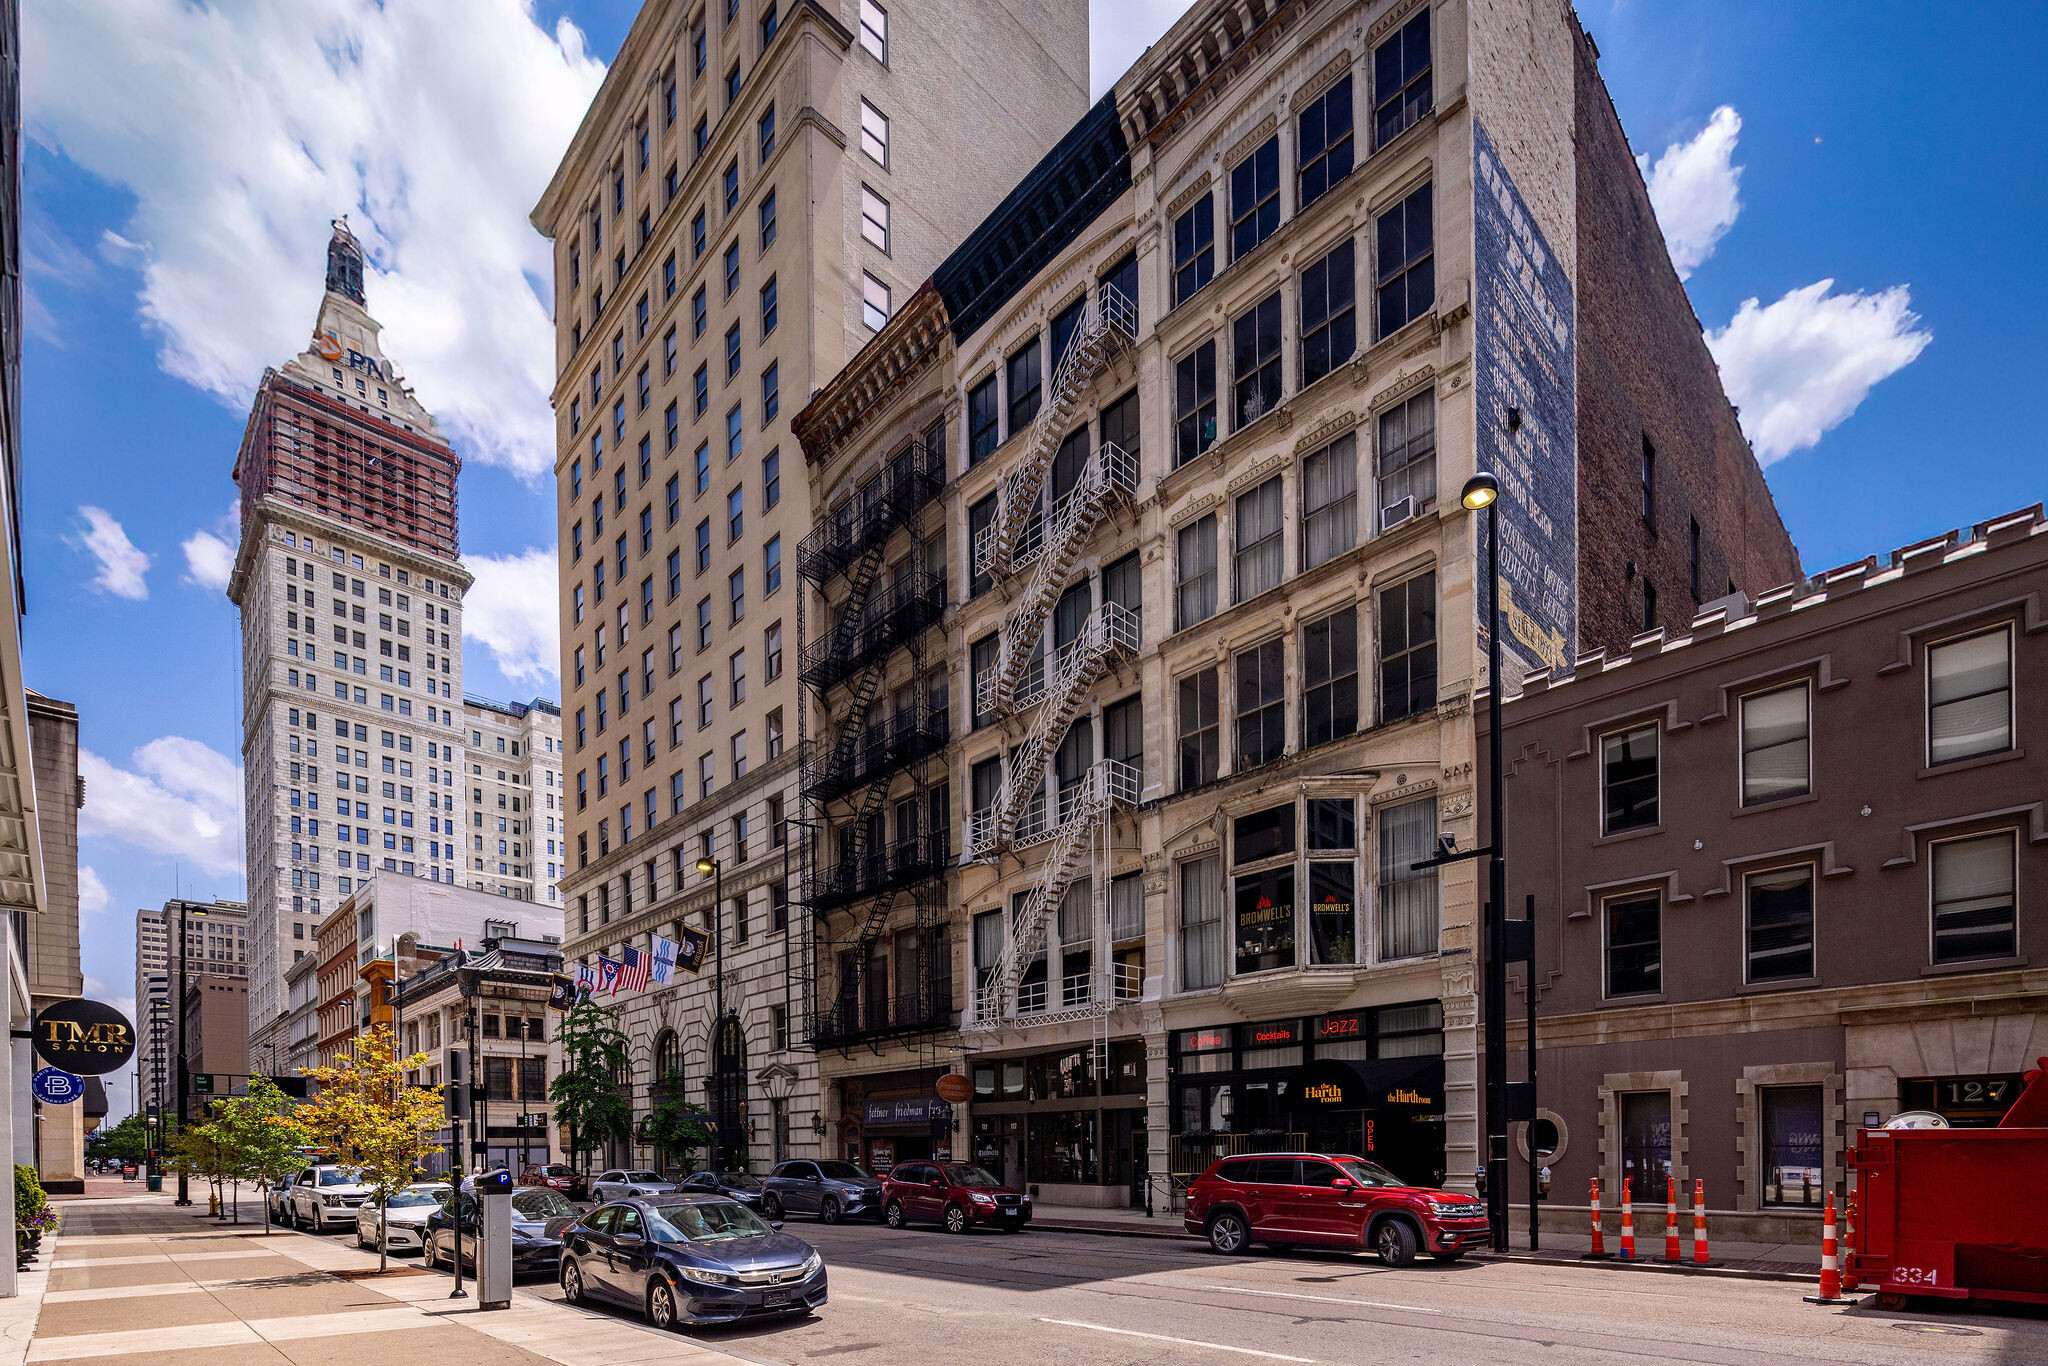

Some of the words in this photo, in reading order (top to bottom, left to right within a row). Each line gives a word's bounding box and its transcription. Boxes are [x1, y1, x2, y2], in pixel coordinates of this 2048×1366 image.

[1479, 151, 1545, 276] GIBSON
[1494, 278, 1515, 325] COLOR
[1494, 305, 1525, 369] PRINTING
[1494, 336, 1535, 408] STATIONERY
[1494, 366, 1518, 408] OFFICE
[1520, 403, 1551, 459] SUPPLIES
[1494, 396, 1533, 462] EQUMENT
[1494, 424, 1533, 491] FURNITURE
[1494, 454, 1527, 512] INTERIOR
[1529, 495, 1553, 540] DESIGN
[1484, 533, 1537, 598] ODUCTS
[1542, 590, 1569, 630] CENTER
[1543, 564, 1569, 605] OFFICE
[1512, 611, 1535, 647] SINCE
[1240, 905, 1291, 926] BROMWELL'S
[1313, 903, 1350, 912] BROMWELL'S
[40, 1020, 133, 1045] TMR
[1256, 1030, 1290, 1041] Cocktails
[1321, 1019, 1358, 1034] Jazz
[52, 1043, 123, 1053] SALON
[1190, 1035, 1221, 1047] Coffee
[37, 1093, 62, 1104] BAKERY
[1387, 1092, 1396, 1102] the
[1418, 1096, 1431, 1104] room
[1947, 1081, 2008, 1103] 127
[895, 1102, 923, 1120] friedman
[1366, 1120, 1375, 1152] OPEN
[1895, 1266, 1937, 1286] 334
